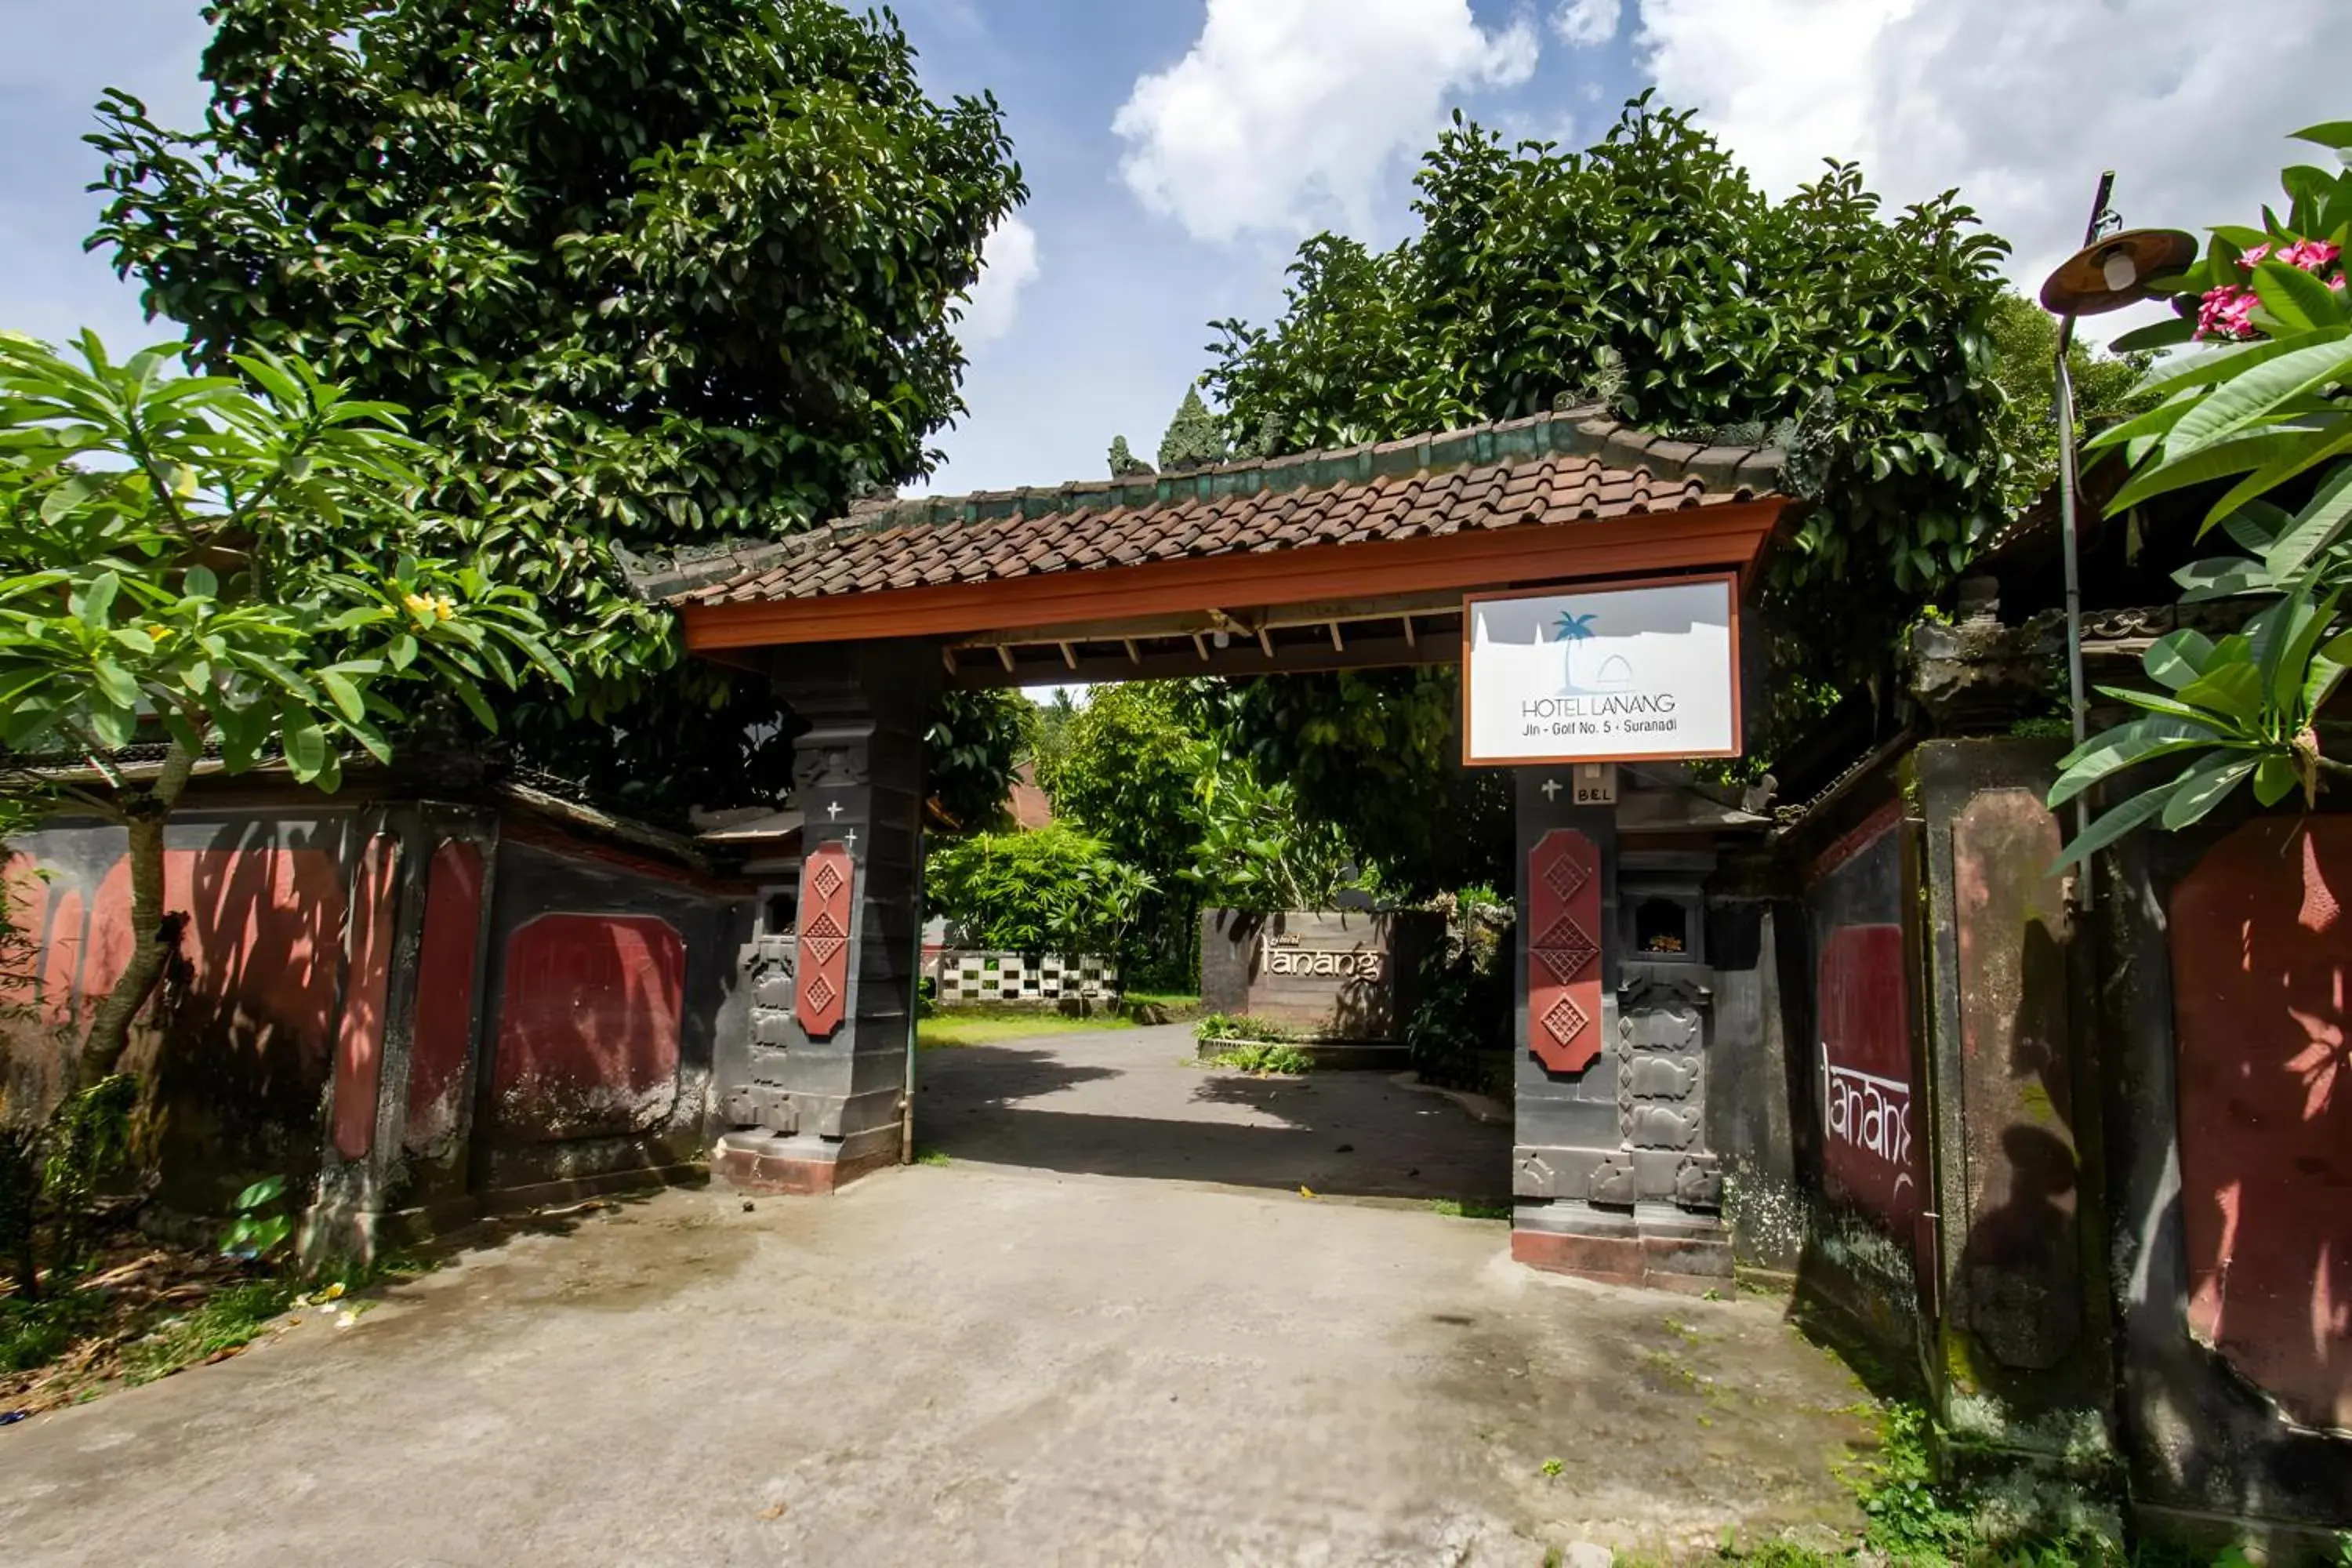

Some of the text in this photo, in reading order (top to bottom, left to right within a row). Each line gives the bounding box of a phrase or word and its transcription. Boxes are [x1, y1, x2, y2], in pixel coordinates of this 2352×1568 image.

[1523, 694, 1675, 717] HOTEL LANANG
[1552, 721, 1575, 735] Golf
[1579, 721, 1600, 735] No.
[1602, 720, 1612, 733] 5
[1623, 718, 1677, 733] Suranadi
[1577, 788, 1613, 801] BEL
[1260, 932, 1381, 982] lanang
